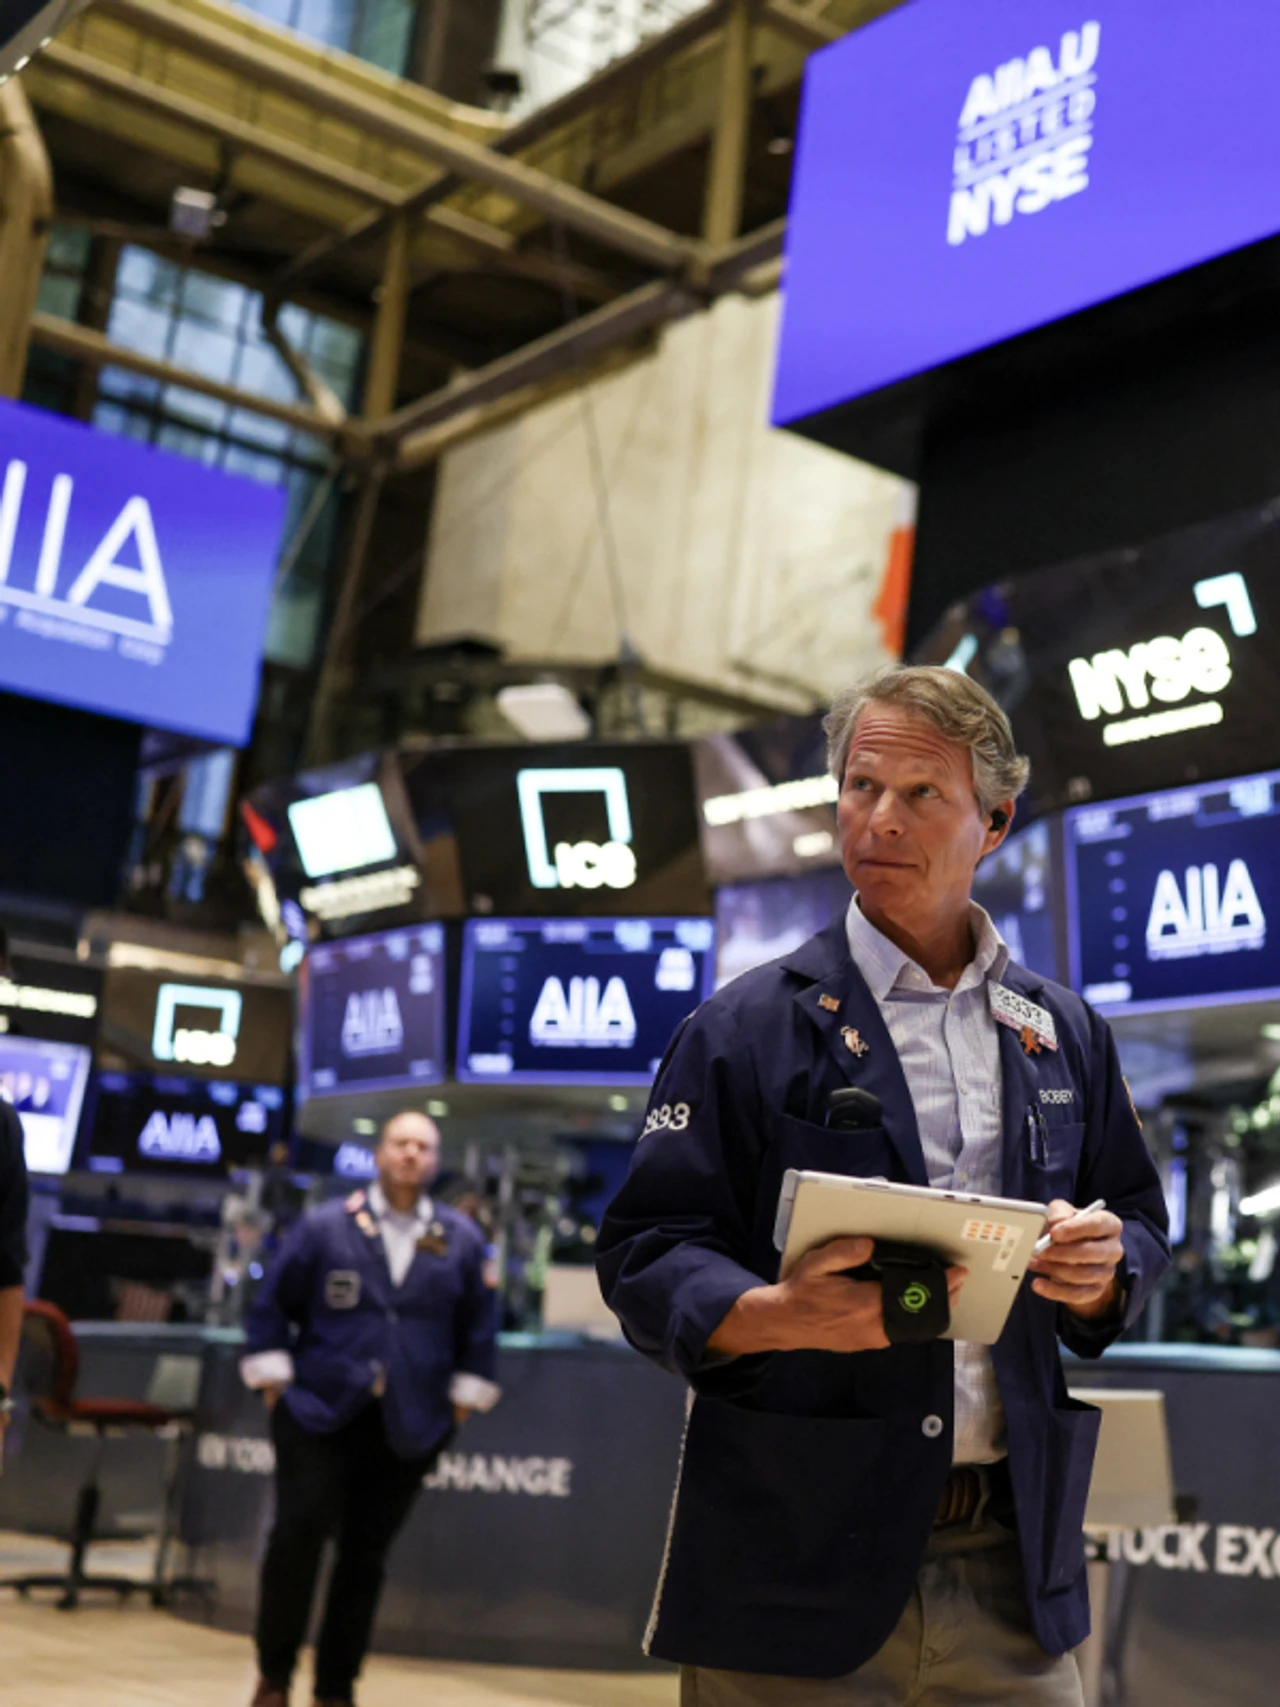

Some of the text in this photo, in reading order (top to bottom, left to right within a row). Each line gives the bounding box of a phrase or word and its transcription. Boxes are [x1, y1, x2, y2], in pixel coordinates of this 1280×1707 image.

[946, 134, 1094, 246] NYSE
[1145, 859, 1266, 938] AIIA
[342, 987, 404, 1044] AIIA
[530, 976, 636, 1036] AIIA
